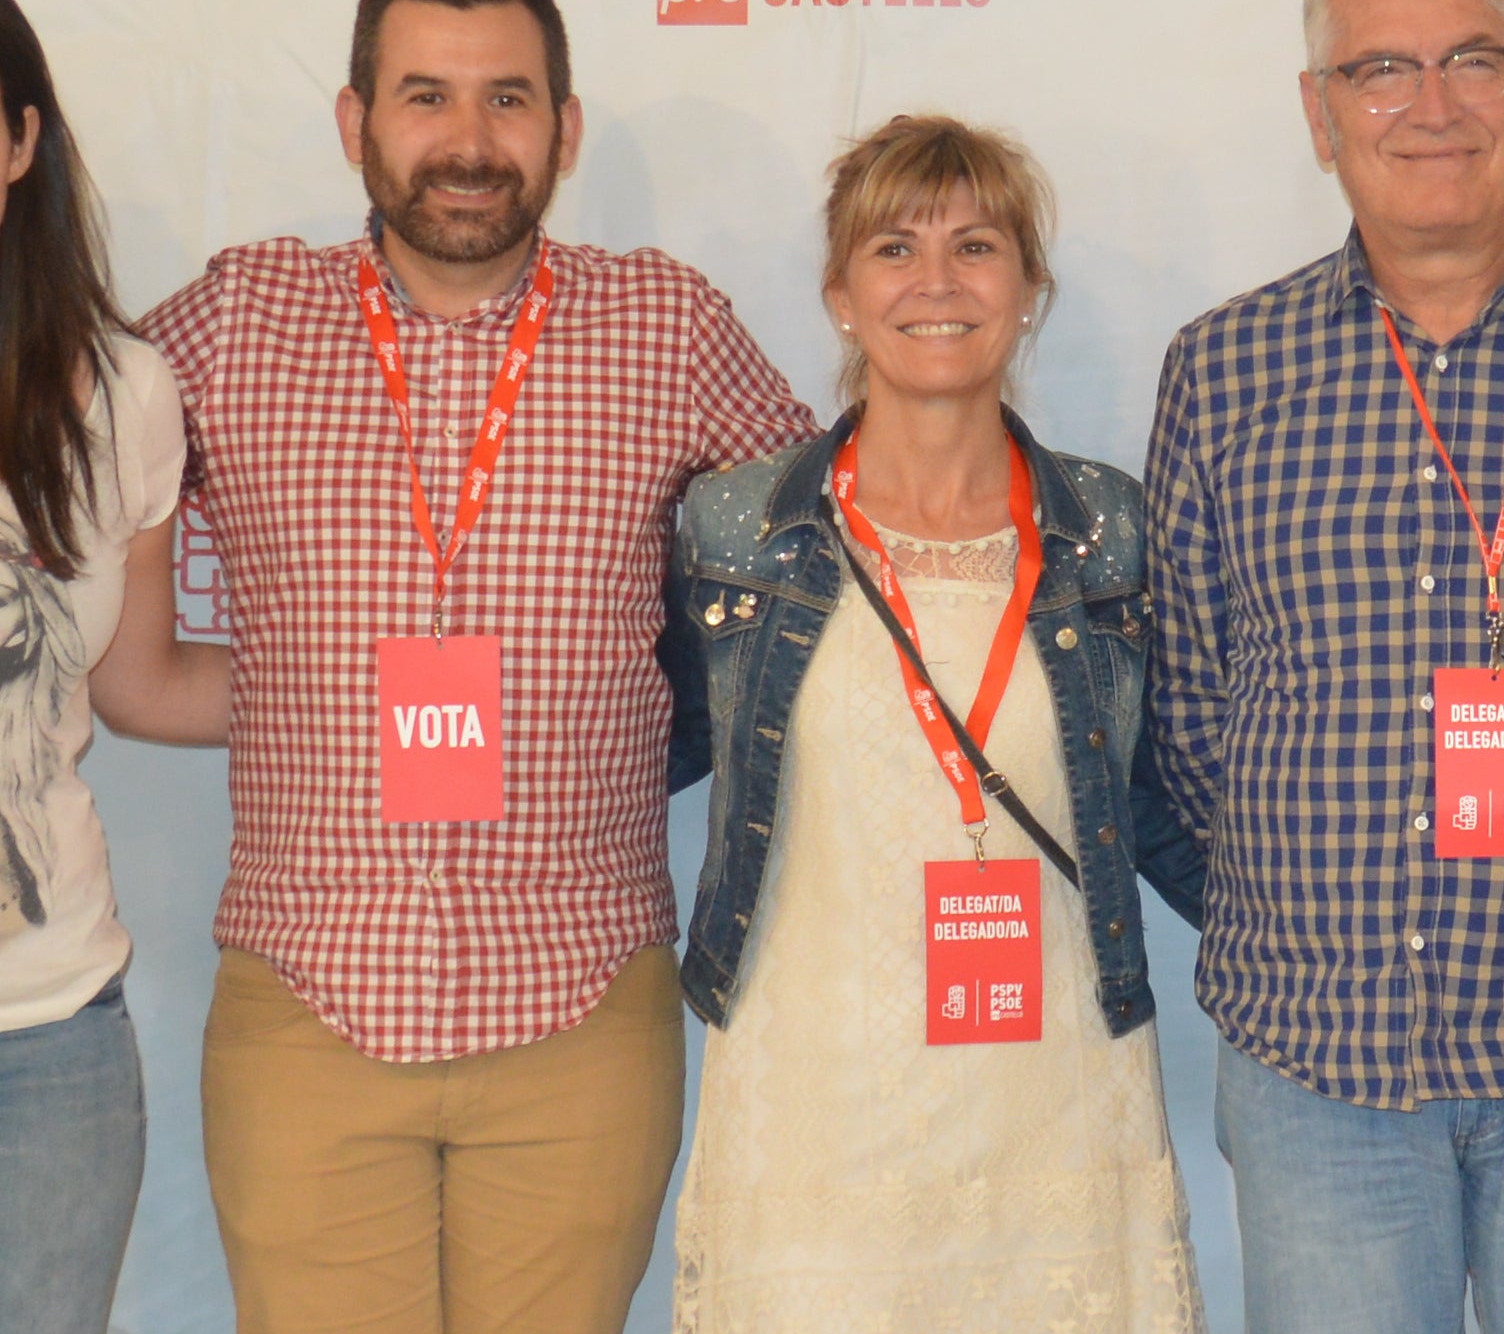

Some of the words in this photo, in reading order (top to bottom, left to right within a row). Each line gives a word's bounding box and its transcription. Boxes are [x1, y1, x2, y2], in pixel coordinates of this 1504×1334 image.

[393, 704, 485, 749] VOTA
[940, 895, 1022, 915] DELEGAT/DA
[934, 921, 1029, 941] DELEGADO/DA
[990, 984, 1023, 997] PSPV
[990, 997, 1023, 1010] PSOE
